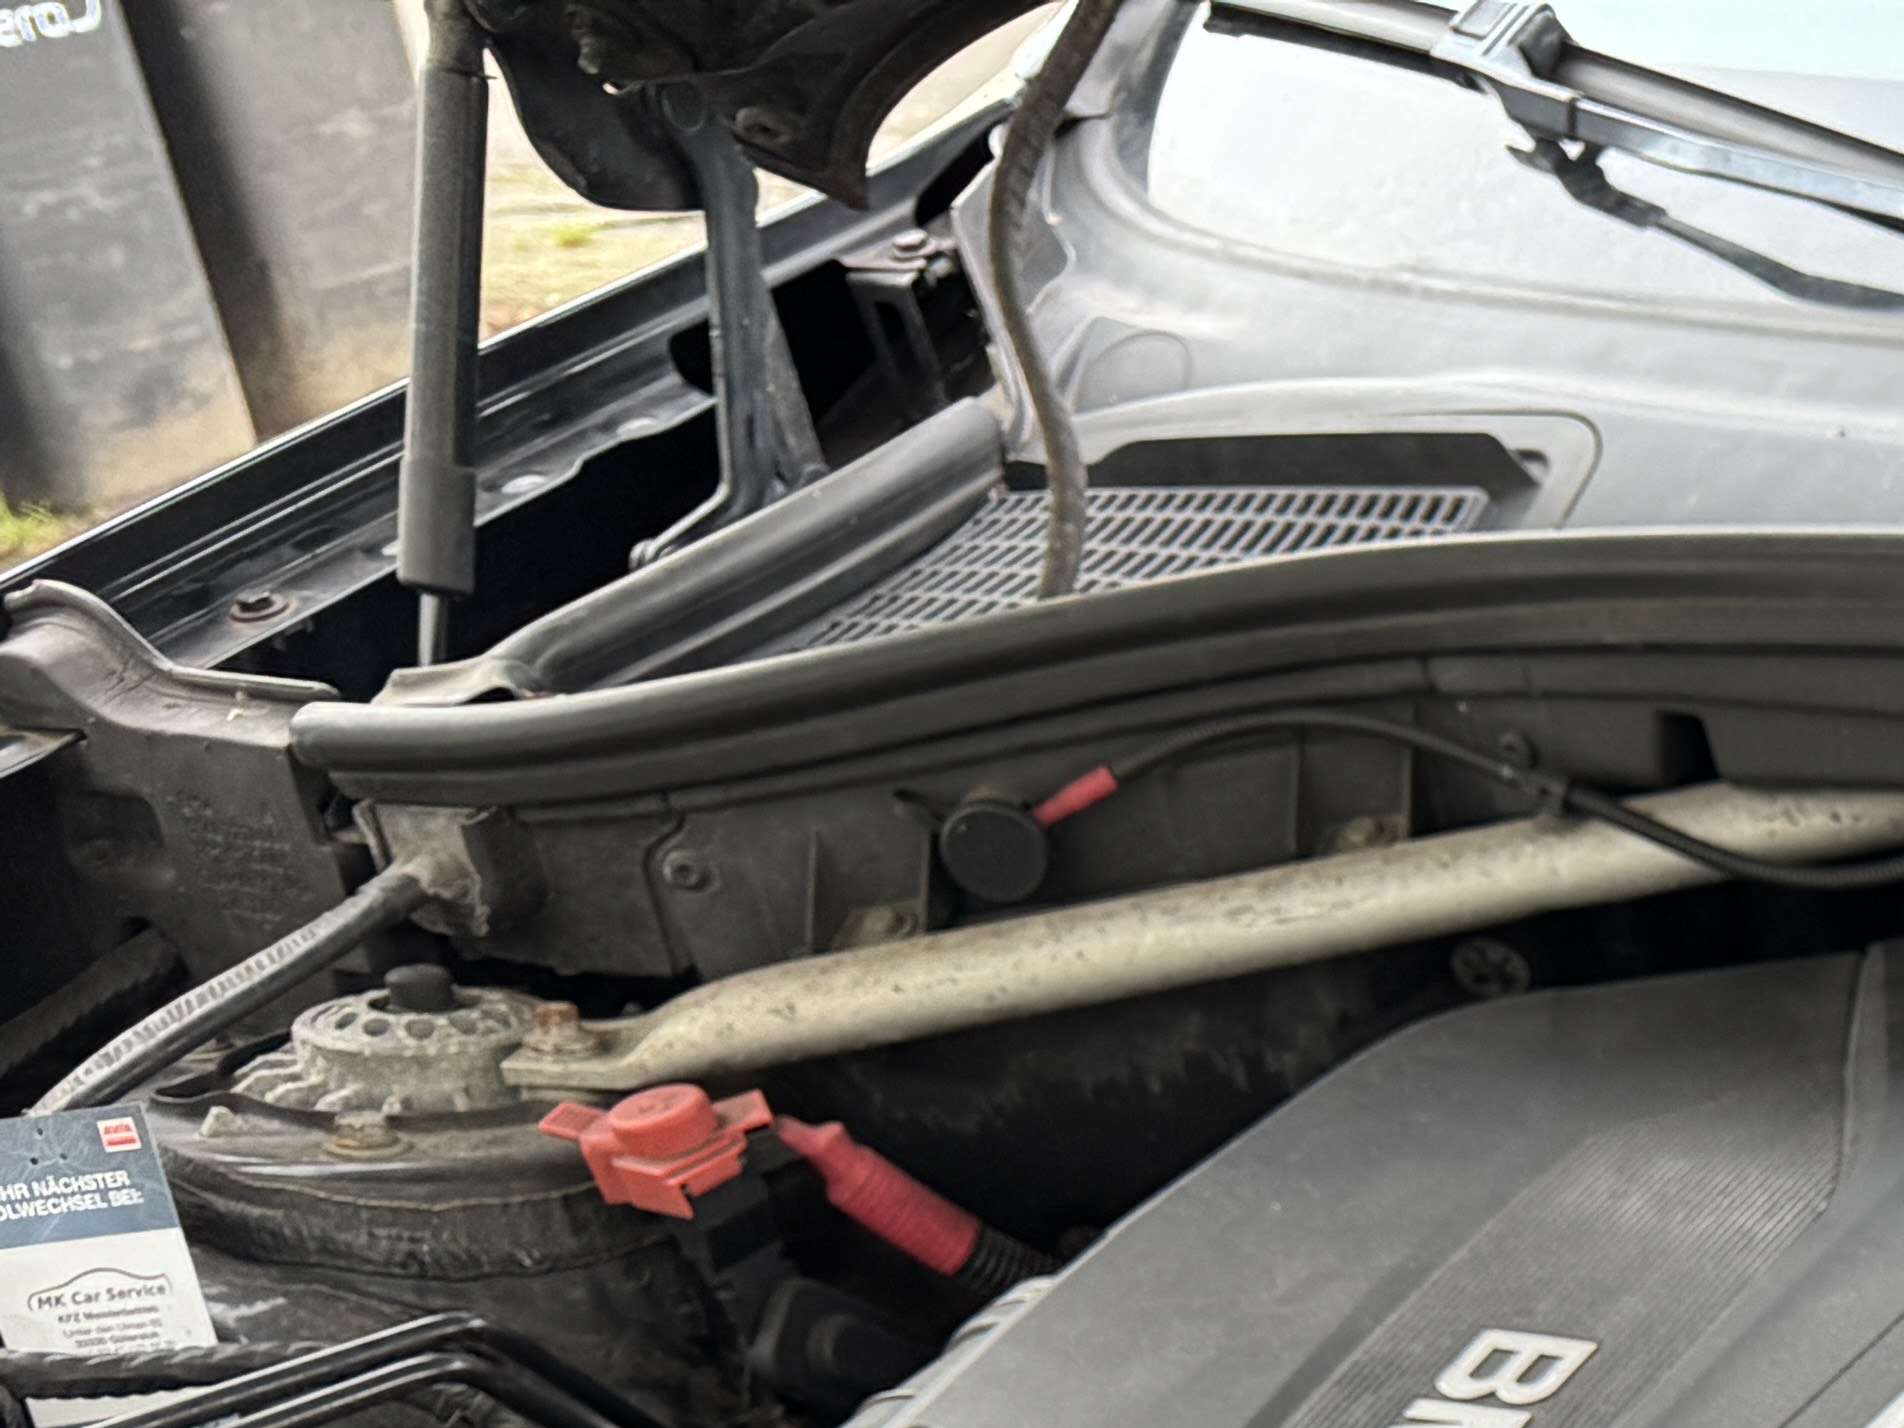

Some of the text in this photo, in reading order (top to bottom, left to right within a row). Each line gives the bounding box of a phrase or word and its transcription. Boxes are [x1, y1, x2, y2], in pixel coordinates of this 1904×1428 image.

[32, 1170, 131, 1198] NÄCHSTER
[38, 1284, 166, 1310] MK Car Service
